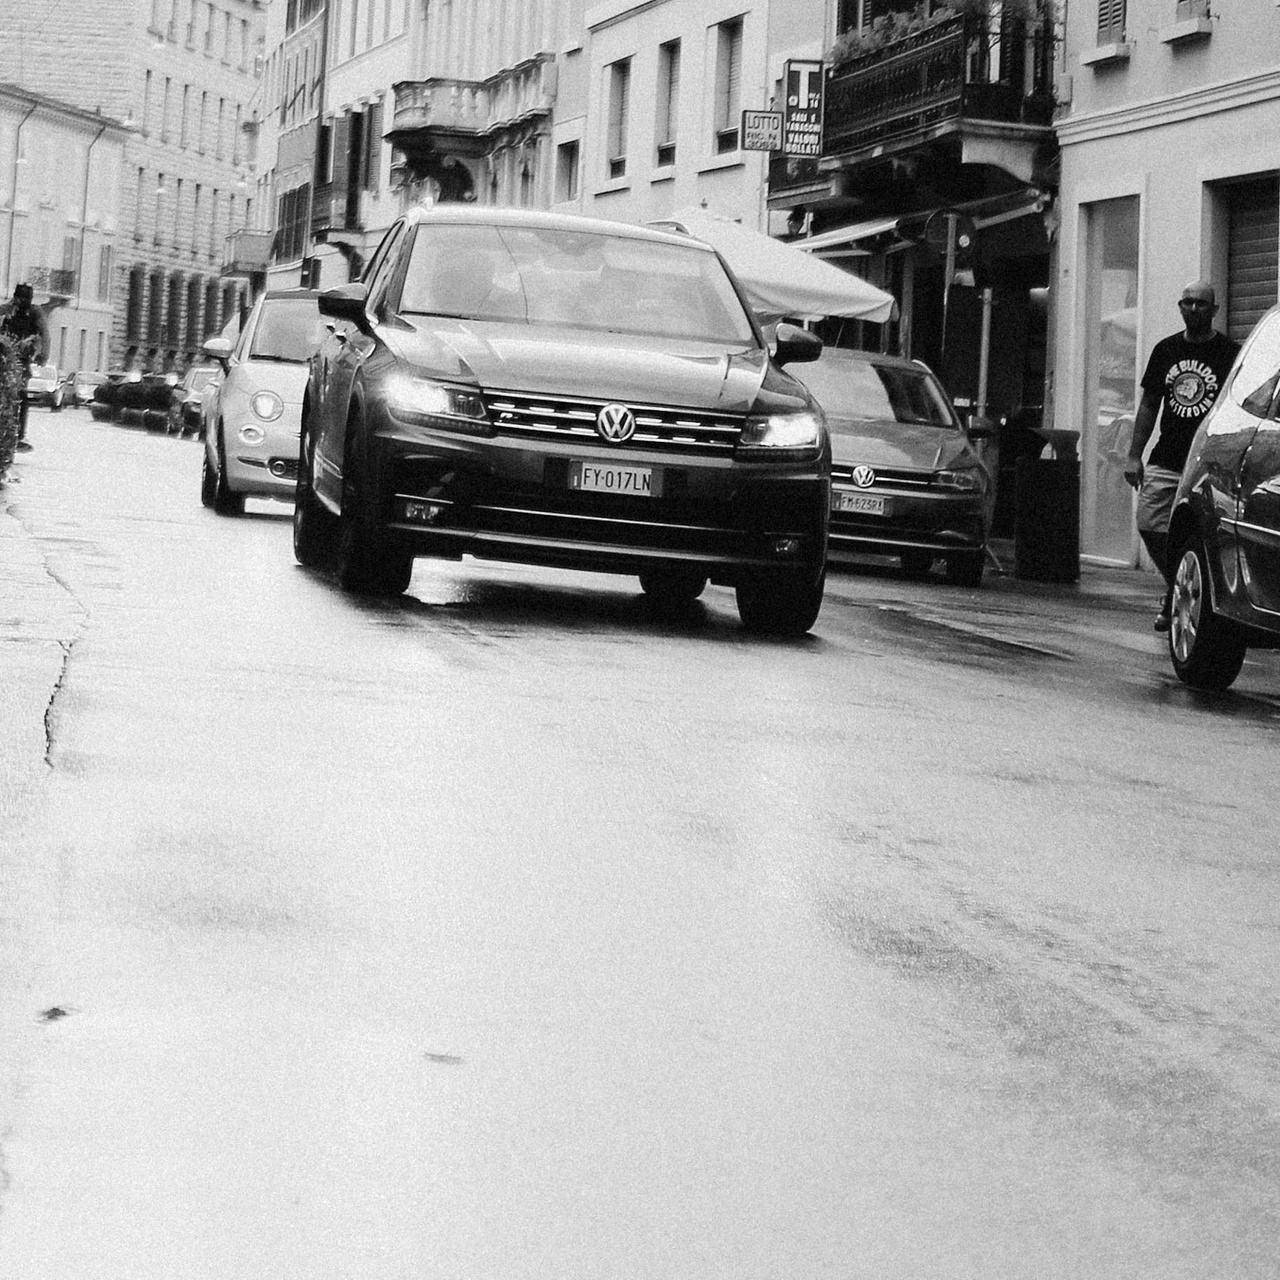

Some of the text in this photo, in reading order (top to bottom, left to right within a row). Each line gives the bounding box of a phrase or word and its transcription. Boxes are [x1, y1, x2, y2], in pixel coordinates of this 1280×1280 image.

[789, 62, 820, 109] T
[747, 115, 780, 130] LOTTO
[787, 133, 819, 144] VALORI
[785, 143, 820, 154] BOLLATI
[1165, 359, 1218, 391] THE BULLDOG
